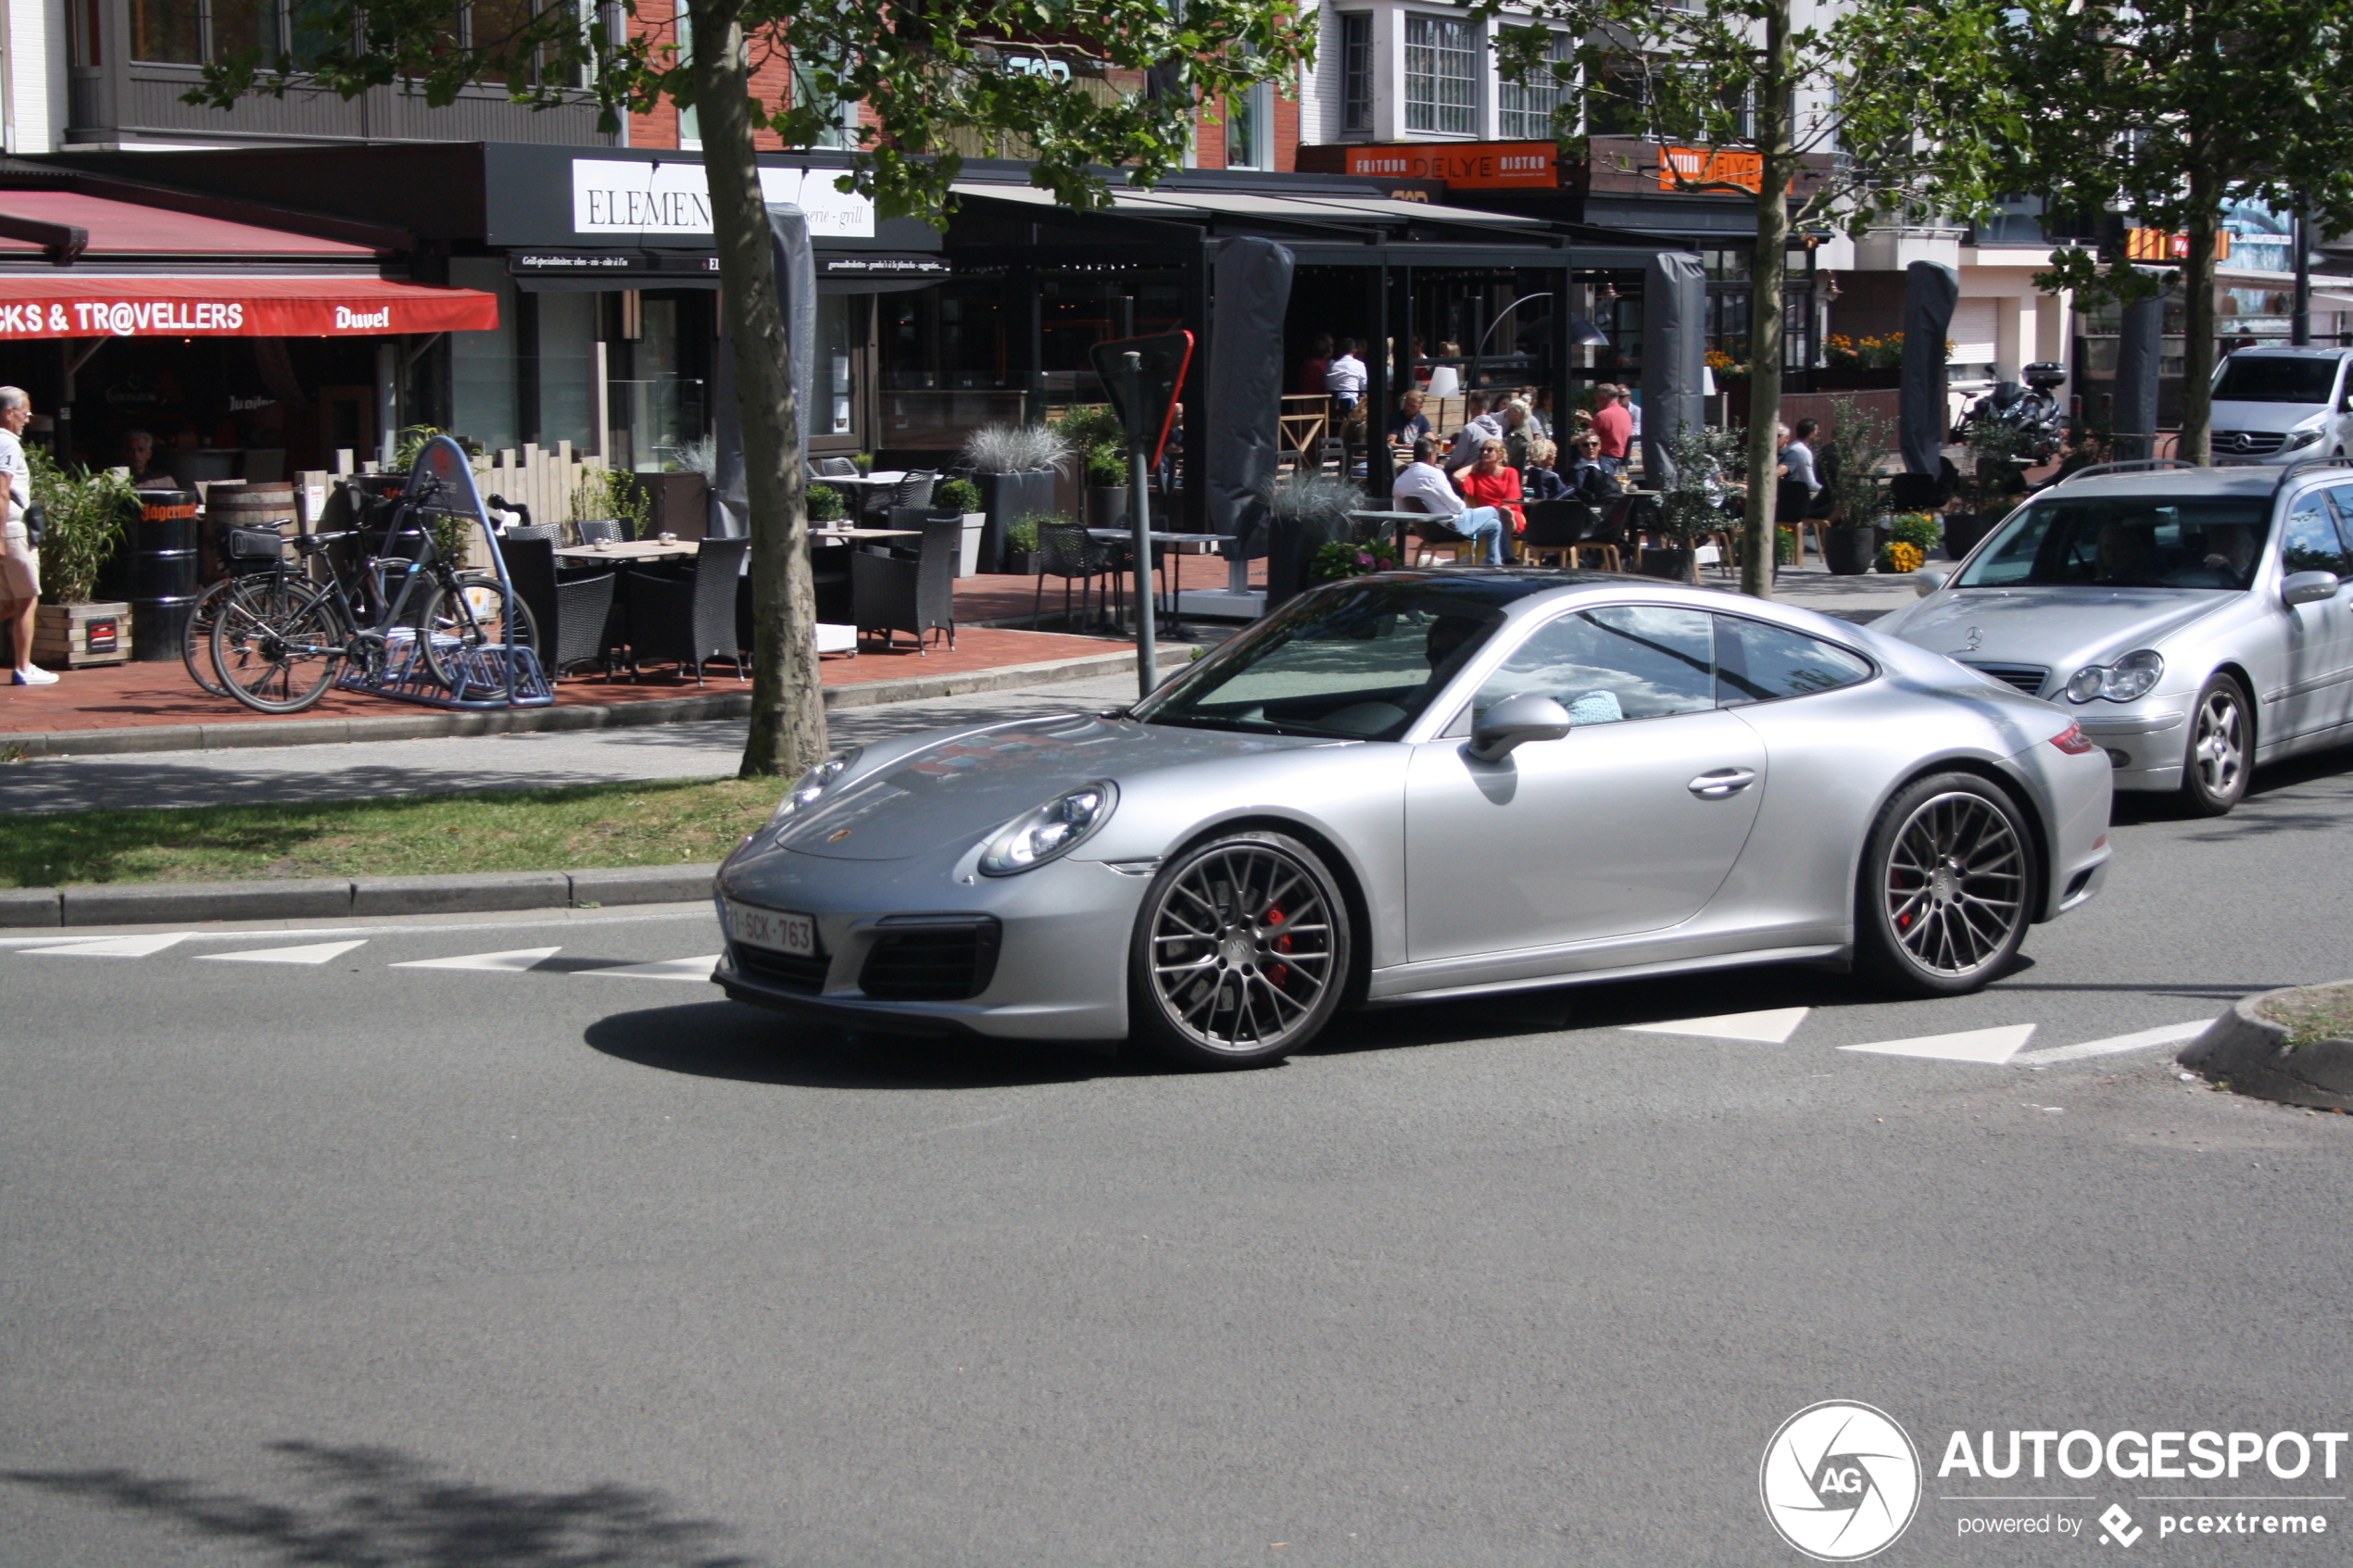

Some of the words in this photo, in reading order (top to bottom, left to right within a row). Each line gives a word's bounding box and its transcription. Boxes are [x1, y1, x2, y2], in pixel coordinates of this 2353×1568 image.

[1356, 159, 1407, 173] FRITUUR
[1414, 157, 1493, 179] DELYE
[1501, 156, 1545, 169] BISTRO
[839, 206, 863, 230] grill
[49, 303, 69, 331] &
[74, 302, 244, 335] TR@VELLERS
[335, 306, 390, 329] Duvel
